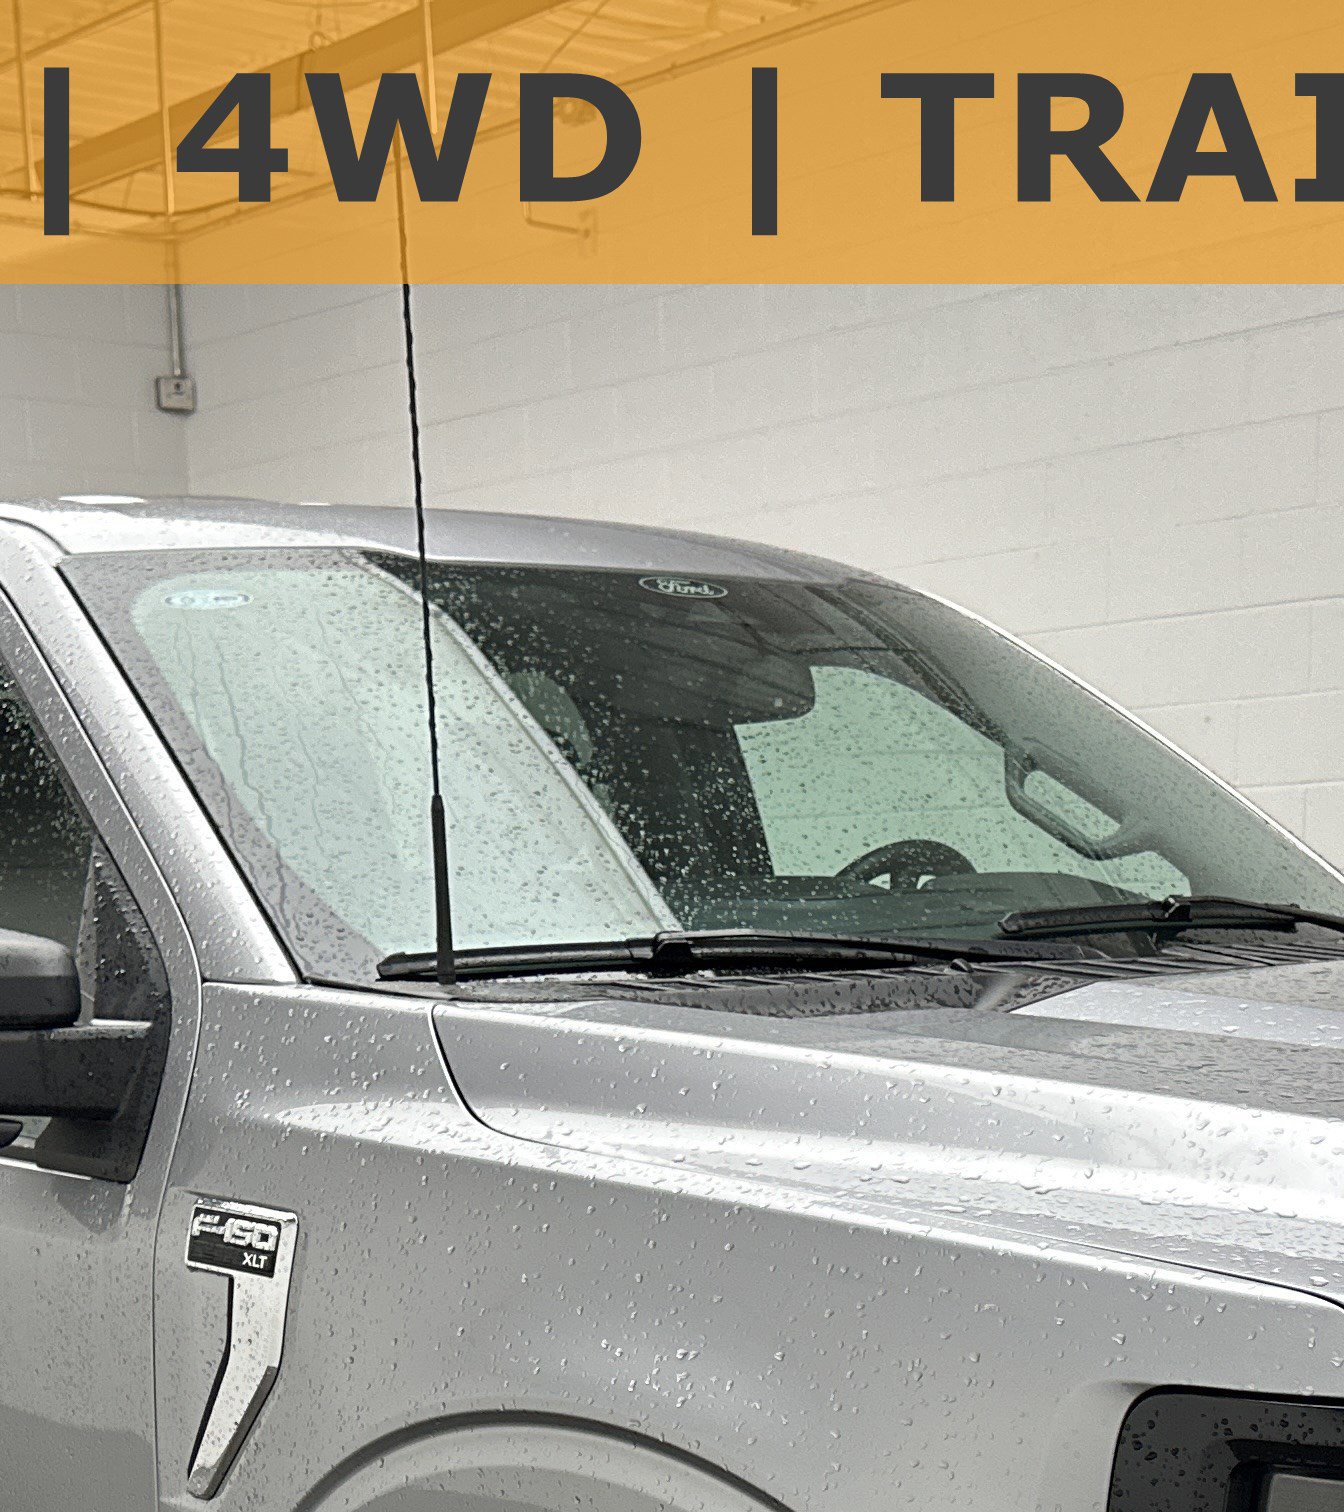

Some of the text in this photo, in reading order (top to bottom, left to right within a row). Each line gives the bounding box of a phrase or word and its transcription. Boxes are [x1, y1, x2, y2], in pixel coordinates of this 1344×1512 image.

[656, 578, 715, 596] Ford
[191, 1213, 278, 1252] F-150
[242, 1252, 268, 1269] XLT
